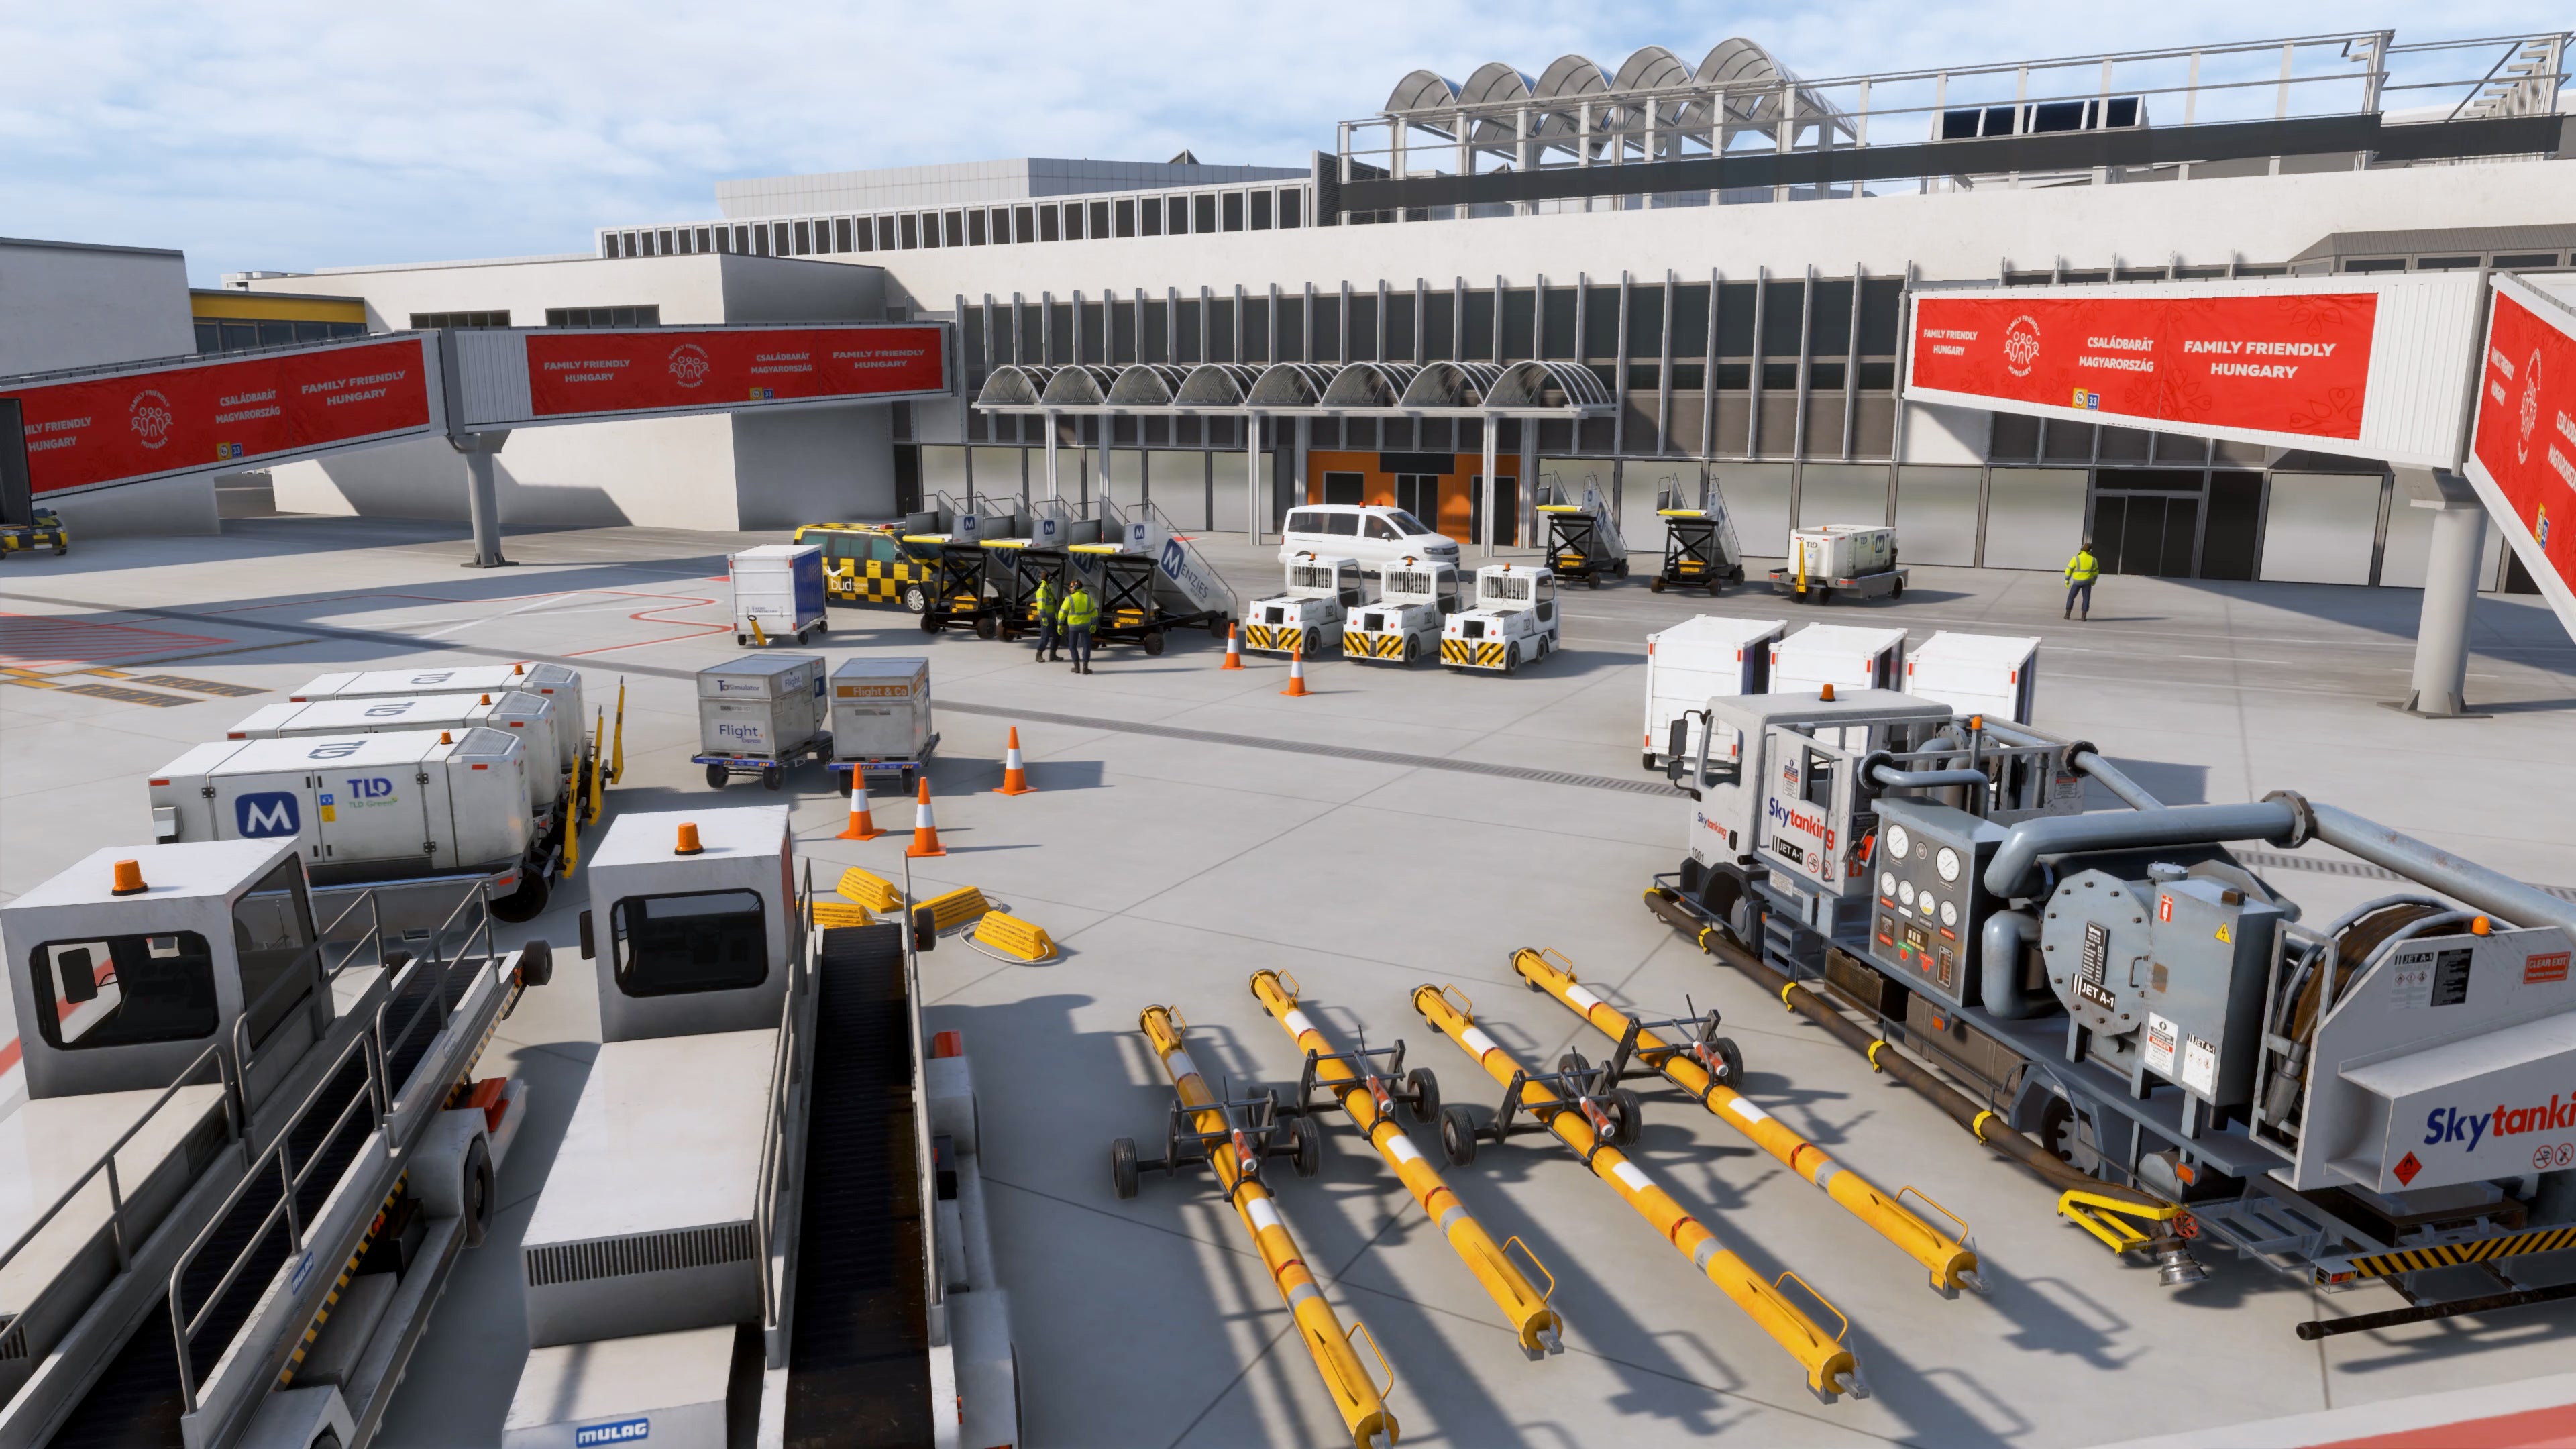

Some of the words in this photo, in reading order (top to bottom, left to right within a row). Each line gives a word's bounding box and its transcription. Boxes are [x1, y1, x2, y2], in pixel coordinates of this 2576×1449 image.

[2006, 316, 2021, 335] FAMILY
[2022, 315, 2041, 336] FRIENDLY
[1923, 329, 1945, 339] FAMILY
[1946, 330, 1978, 340] FRIENDLY
[669, 344, 684, 360] FAMILY
[685, 343, 708, 359] FRIENDLY
[756, 352, 810, 362] CSALÁDBARÁT
[833, 351, 872, 359] FAMILY
[875, 349, 925, 357] FRIENDLY
[1933, 345, 1965, 356] HUNGARY
[2184, 341, 2243, 354] FAMILY
[2245, 341, 2336, 357] FRIENDLY
[544, 360, 581, 370] FAMILY
[584, 360, 630, 368] FRIENDLY
[751, 364, 812, 374] MAGYARORSZÁG
[854, 360, 907, 368] HUNGARY
[2008, 364, 2031, 377] HUNGARY
[2079, 356, 2153, 372] MAGYARORSZÁG
[2210, 363, 2298, 378] HUNGARY
[302, 379, 346, 394] FAMILY
[350, 370, 405, 386] FRIENDLY
[564, 373, 614, 382] HUNGARY
[677, 380, 704, 388] HUNGARY
[129, 391, 145, 412] FAMILY
[145, 390, 170, 407] FRIENDLY
[219, 389, 276, 407] CSALÁDBARÁT
[327, 388, 386, 406] HUNGARY
[2089, 396, 2097, 406] 33
[215, 406, 280, 424] MAGYARORSZÁG
[25, 423, 42, 435] ILY
[45, 417, 91, 433] FRIENDLY
[28, 436, 77, 452] HUNGARY
[141, 436, 168, 449] HUNGARY
[233, 446, 241, 455] 33
[830, 578, 852, 591] bud
[785, 675, 800, 687] Flight
[853, 686, 881, 696] Flight
[884, 687, 892, 696] &
[894, 686, 907, 696] Co
[307, 740, 368, 759] TLD
[347, 777, 392, 798] TLD
[349, 800, 363, 808] TLD
[366, 799, 394, 808] Green
[247, 799, 292, 833] M
[1769, 797, 1835, 851] Skytanking
[1697, 812, 1727, 840] Skytanking
[1691, 847, 1705, 863] 1001
[1779, 841, 1792, 854] JET
[1792, 849, 1803, 861] A-1
[2404, 953, 2418, 964] JET
[2419, 952, 2433, 963] A-1
[2528, 959, 2551, 969] CLEAR
[2552, 957, 2567, 966] EXIT
[2082, 982, 2098, 999] JET
[2100, 991, 2114, 1008] A-1
[2151, 1037, 2170, 1051] DANGER
[2194, 1036, 2206, 1048] JET
[2206, 1042, 2216, 1055] A-1
[292, 1254, 313, 1291] MULAG
[578, 1422, 647, 1444] MULAG
